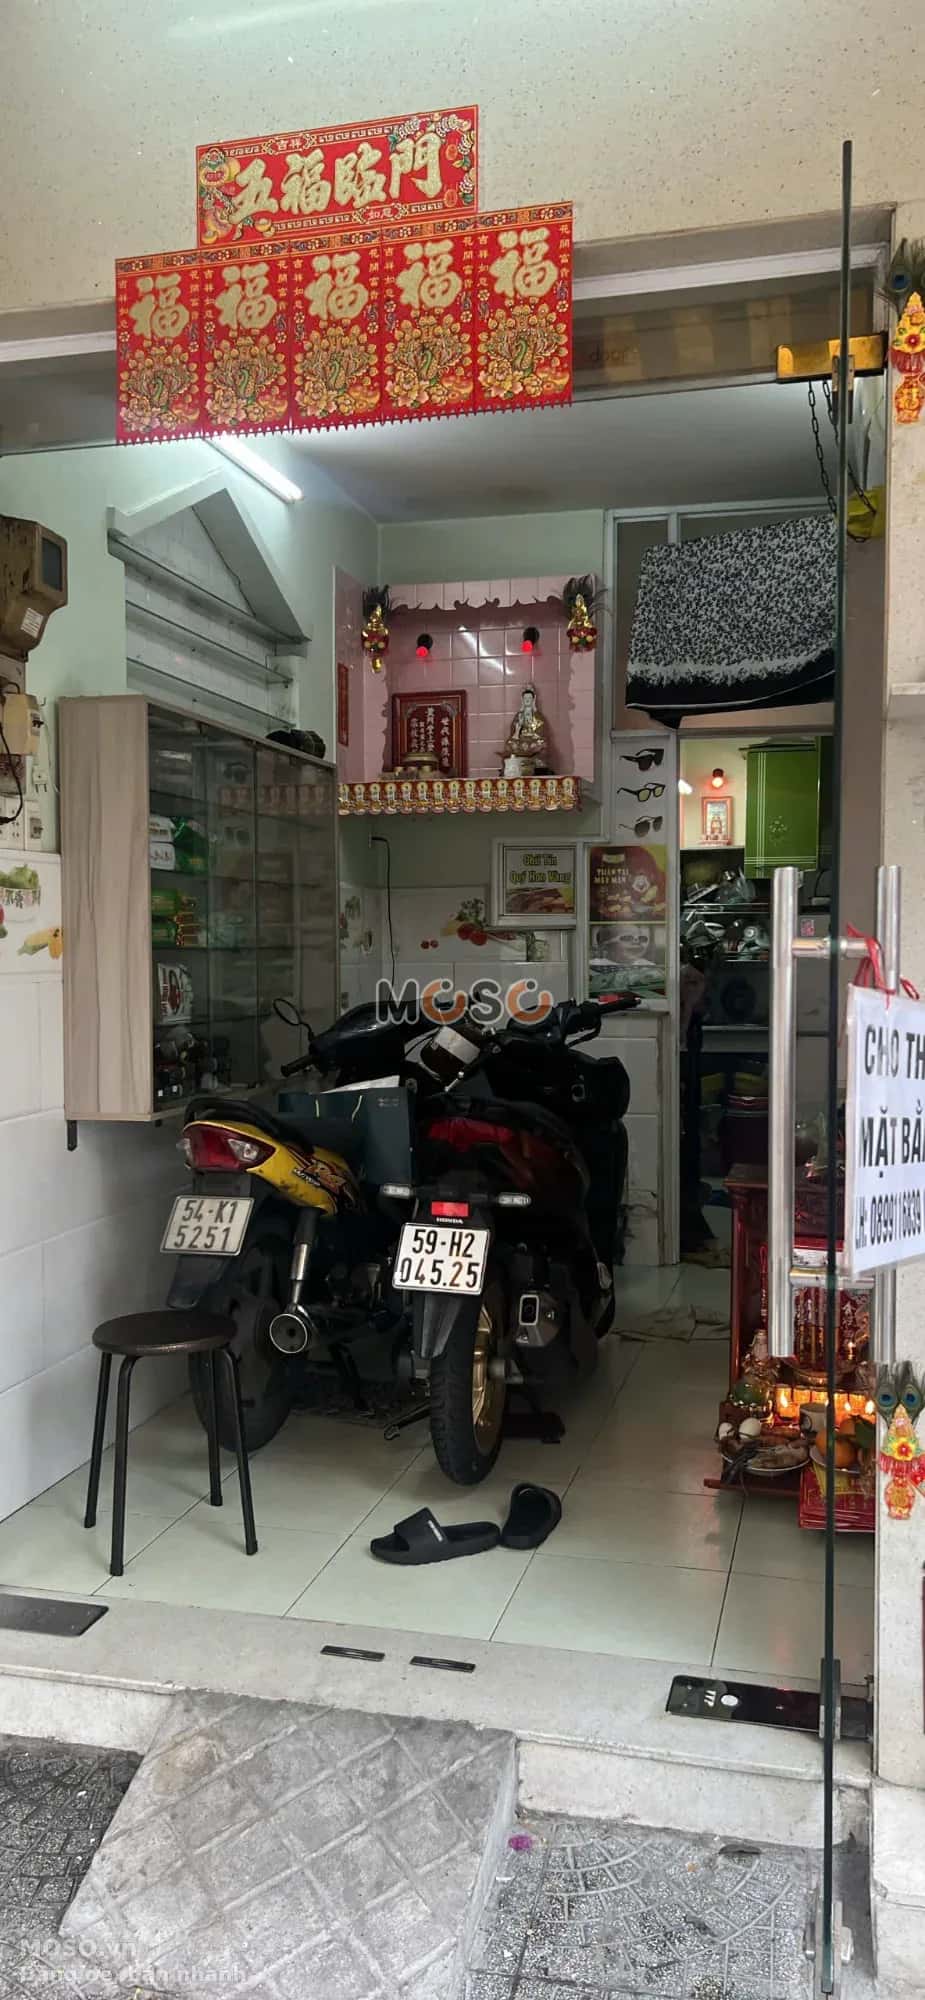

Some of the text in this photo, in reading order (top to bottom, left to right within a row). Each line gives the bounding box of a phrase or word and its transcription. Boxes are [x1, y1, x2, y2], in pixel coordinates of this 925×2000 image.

[215, 262, 278, 330] 福
[304, 252, 369, 321] 福
[396, 239, 462, 309] 福
[488, 227, 558, 298] 福
[129, 271, 190, 339] 福
[864, 1024, 900, 1078] CHO
[859, 1105, 897, 1178] MẶT
[173, 1225, 231, 1250] 5251
[181, 1199, 239, 1224] 54-K1
[411, 1229, 475, 1258] 59-H2
[399, 1257, 480, 1289] 045.25
